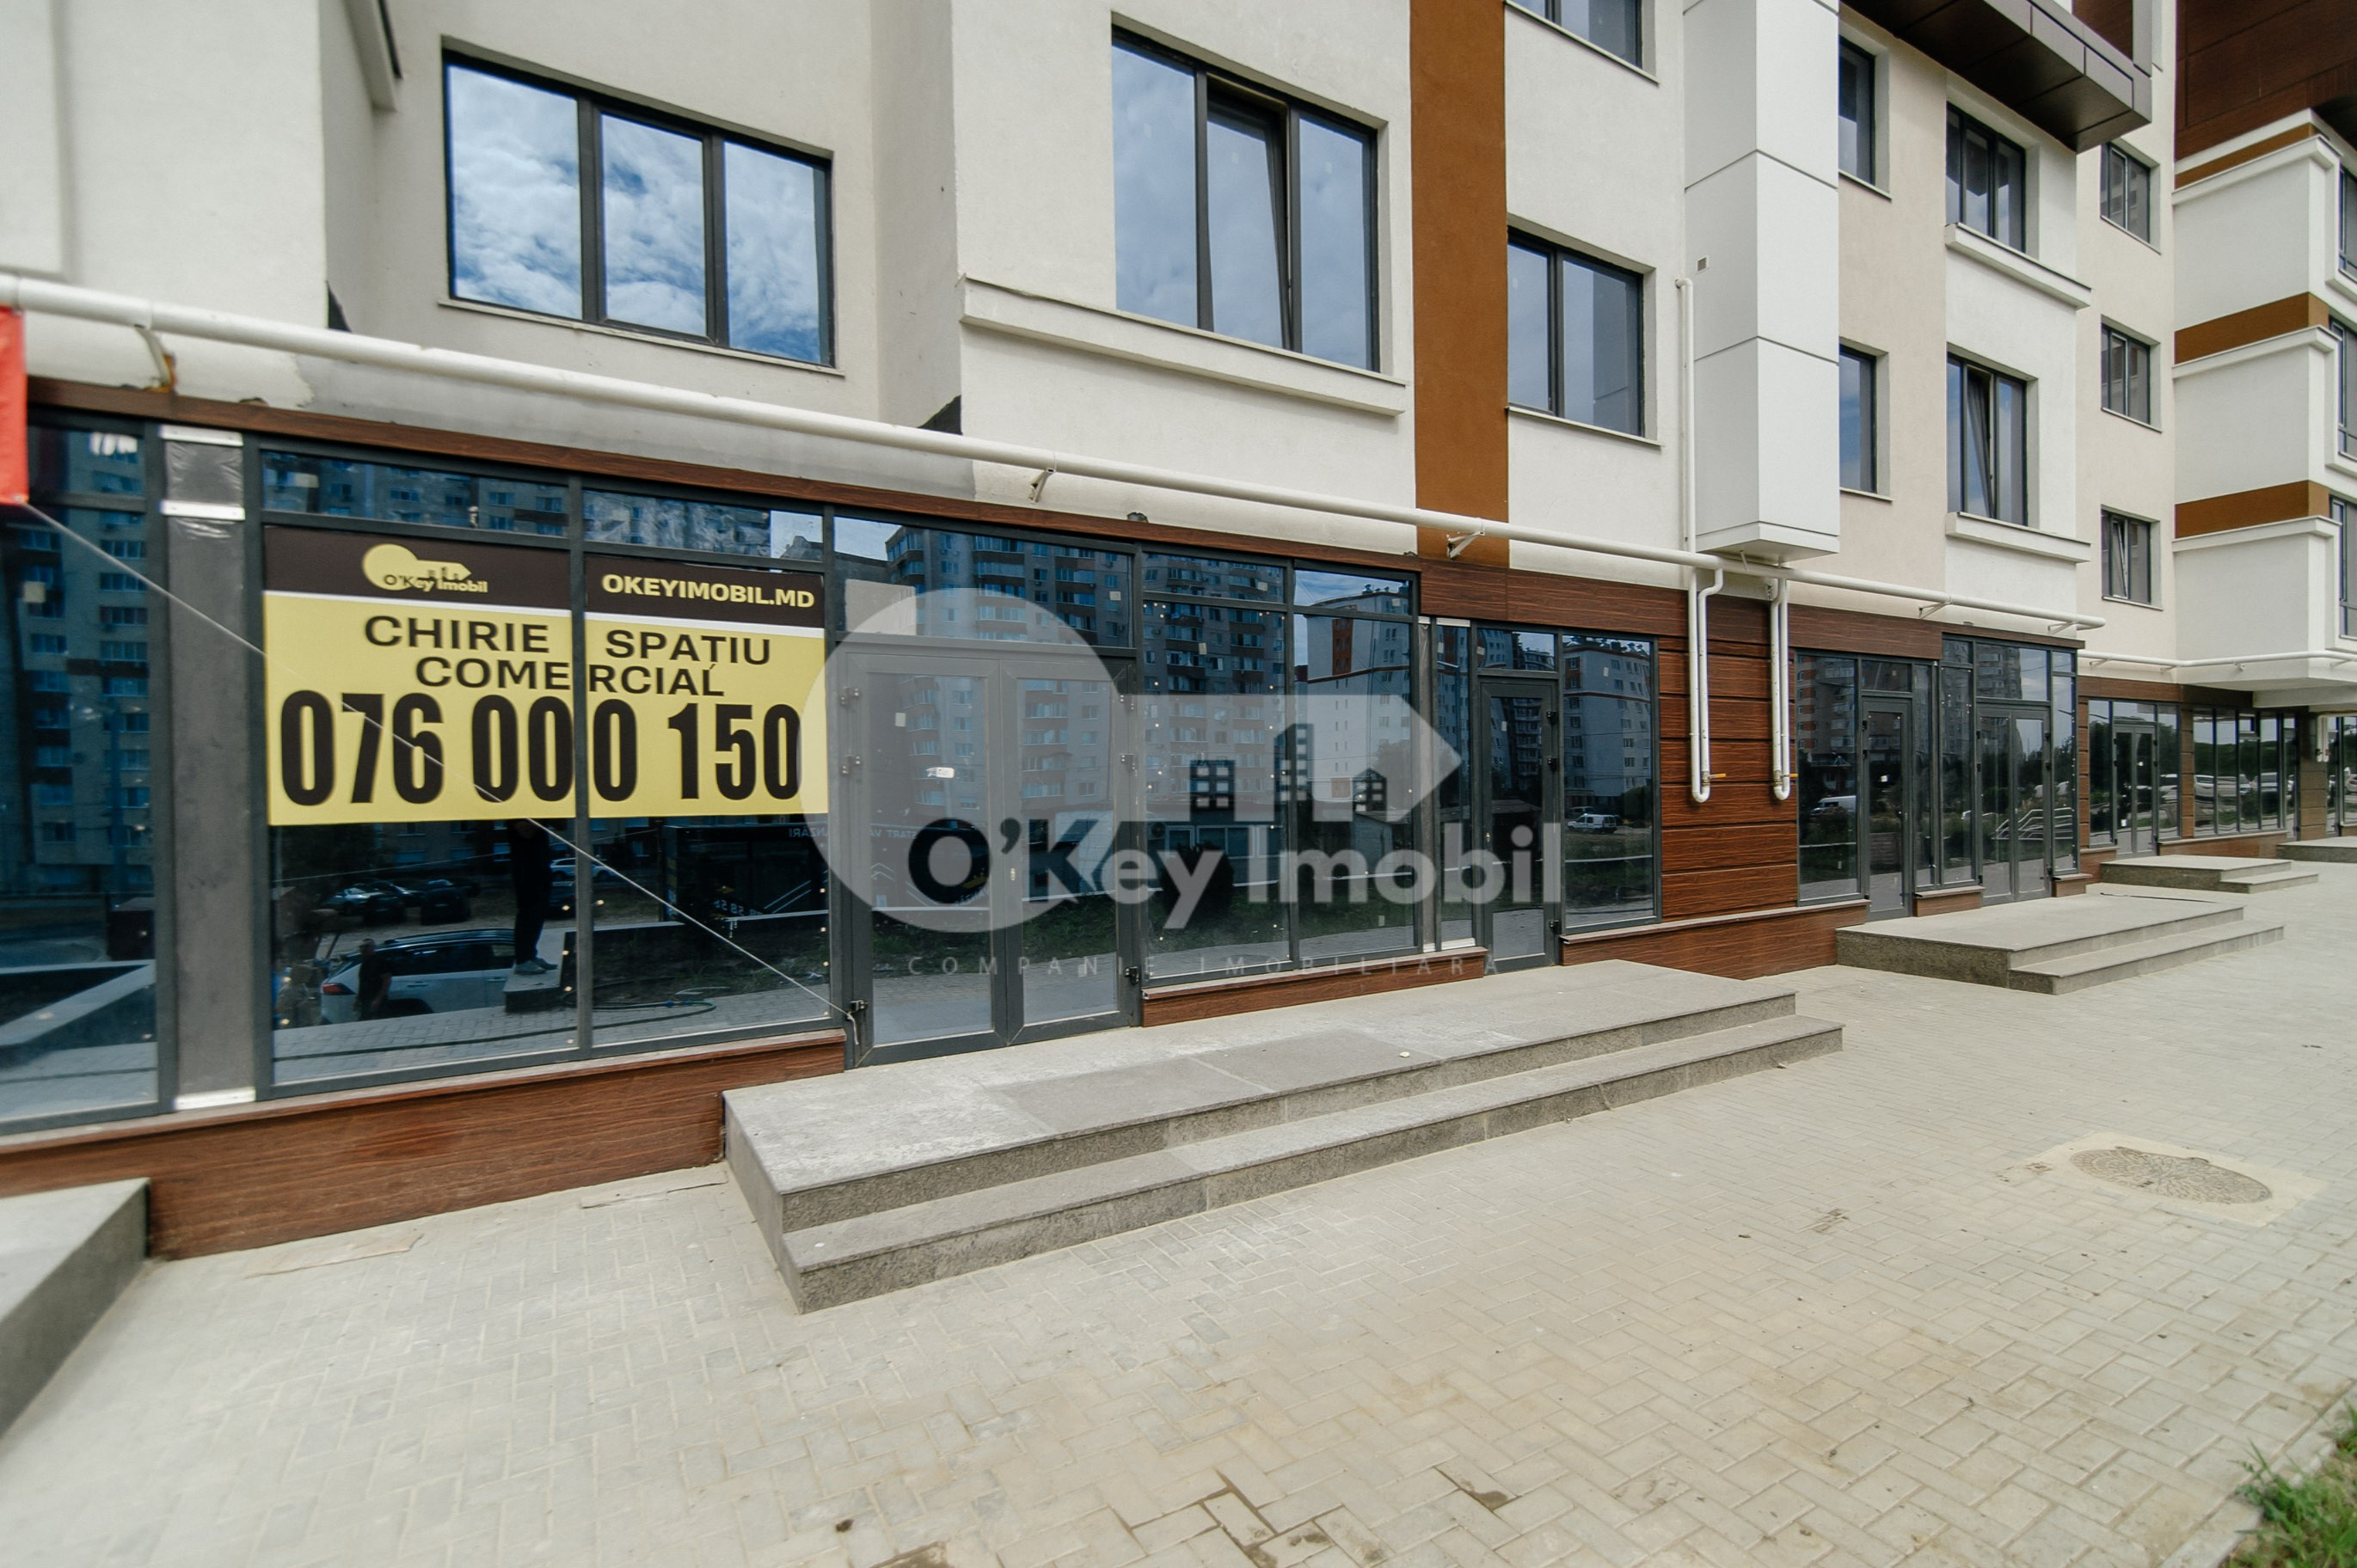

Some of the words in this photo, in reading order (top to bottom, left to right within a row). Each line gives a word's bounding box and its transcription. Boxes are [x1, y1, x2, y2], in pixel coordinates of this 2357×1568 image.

[437, 579, 488, 593] Imobil
[602, 573, 814, 608] OKEYIMOBIL.MD
[365, 616, 549, 653] CHIRIE
[416, 656, 724, 696] COMERCIAL
[280, 689, 444, 805] 076
[471, 695, 638, 803] 000
[668, 702, 801, 801] 150
